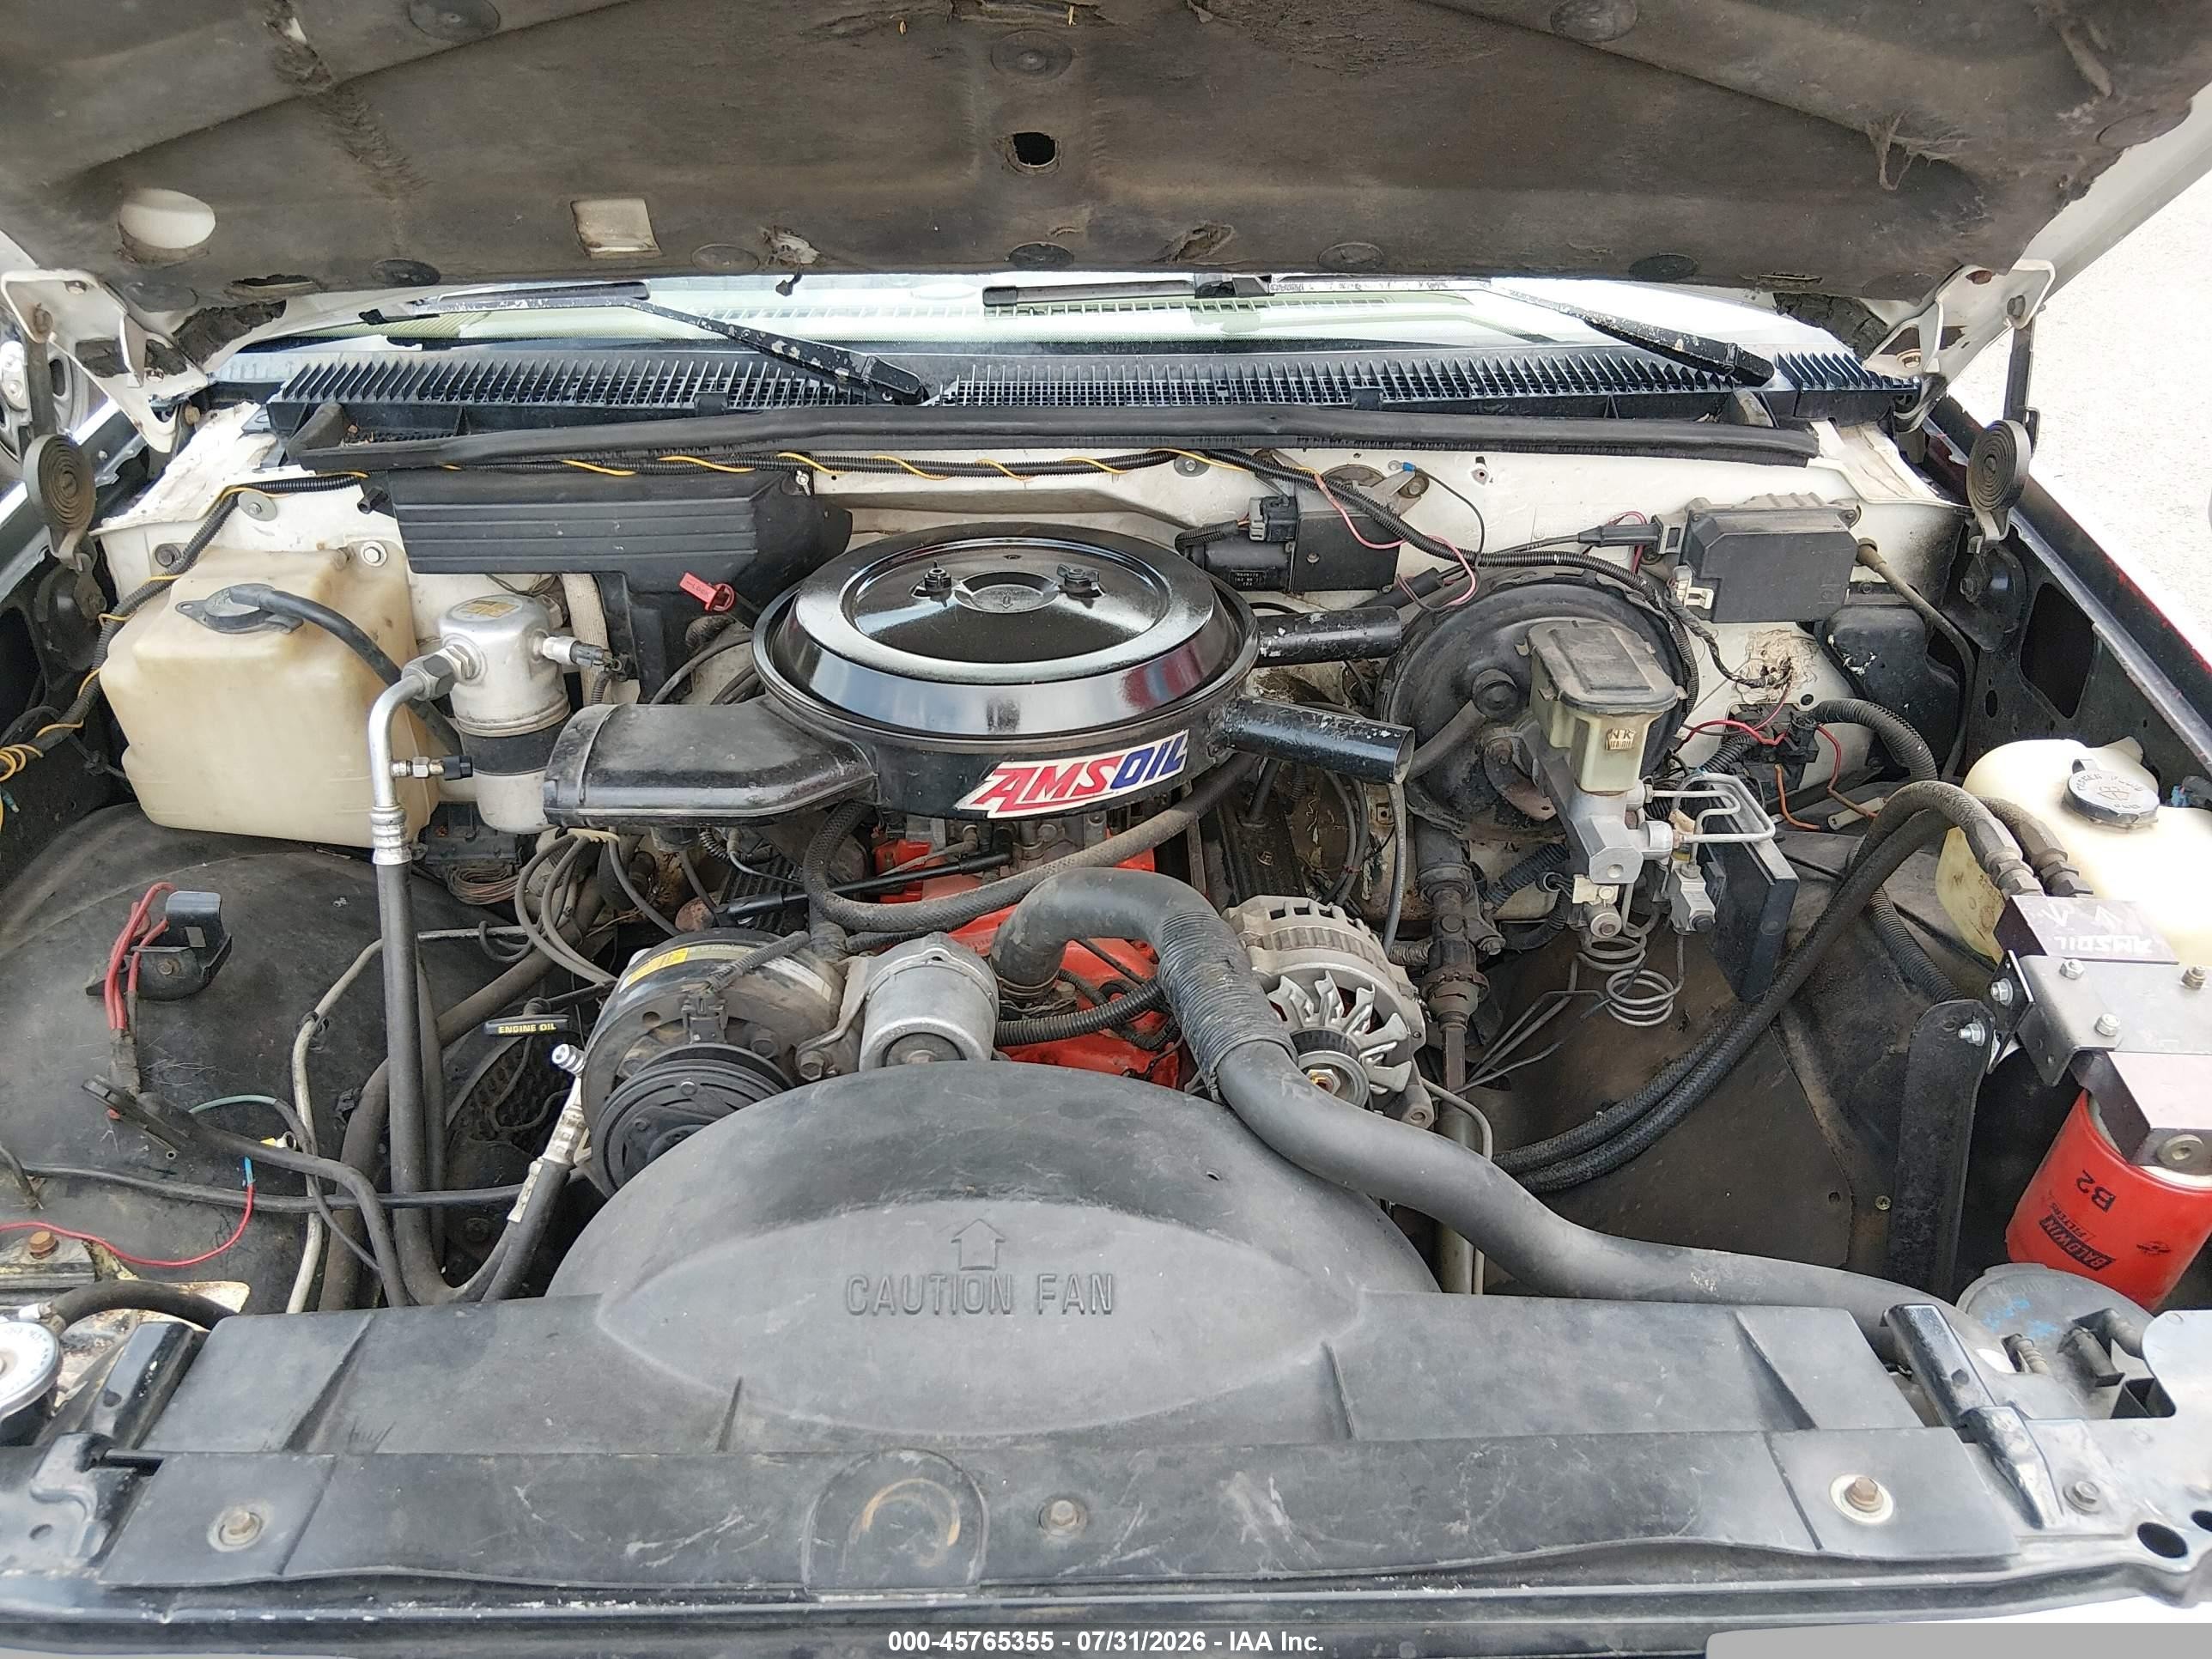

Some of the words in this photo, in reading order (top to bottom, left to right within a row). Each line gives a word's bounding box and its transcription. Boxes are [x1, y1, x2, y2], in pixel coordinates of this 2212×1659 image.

[970, 734, 1186, 812] AMSOIL
[2053, 934, 2154, 955] AMSOIL
[498, 1024, 536, 1035] ENGINE
[539, 1023, 557, 1031] OIL
[2075, 1169, 2118, 1213] B2
[2041, 1213, 2111, 1270] BALDWIN
[2048, 1202, 2087, 1239] FILTERS
[845, 1273, 1013, 1316] CAUTION
[1036, 1273, 1114, 1316] FAN
